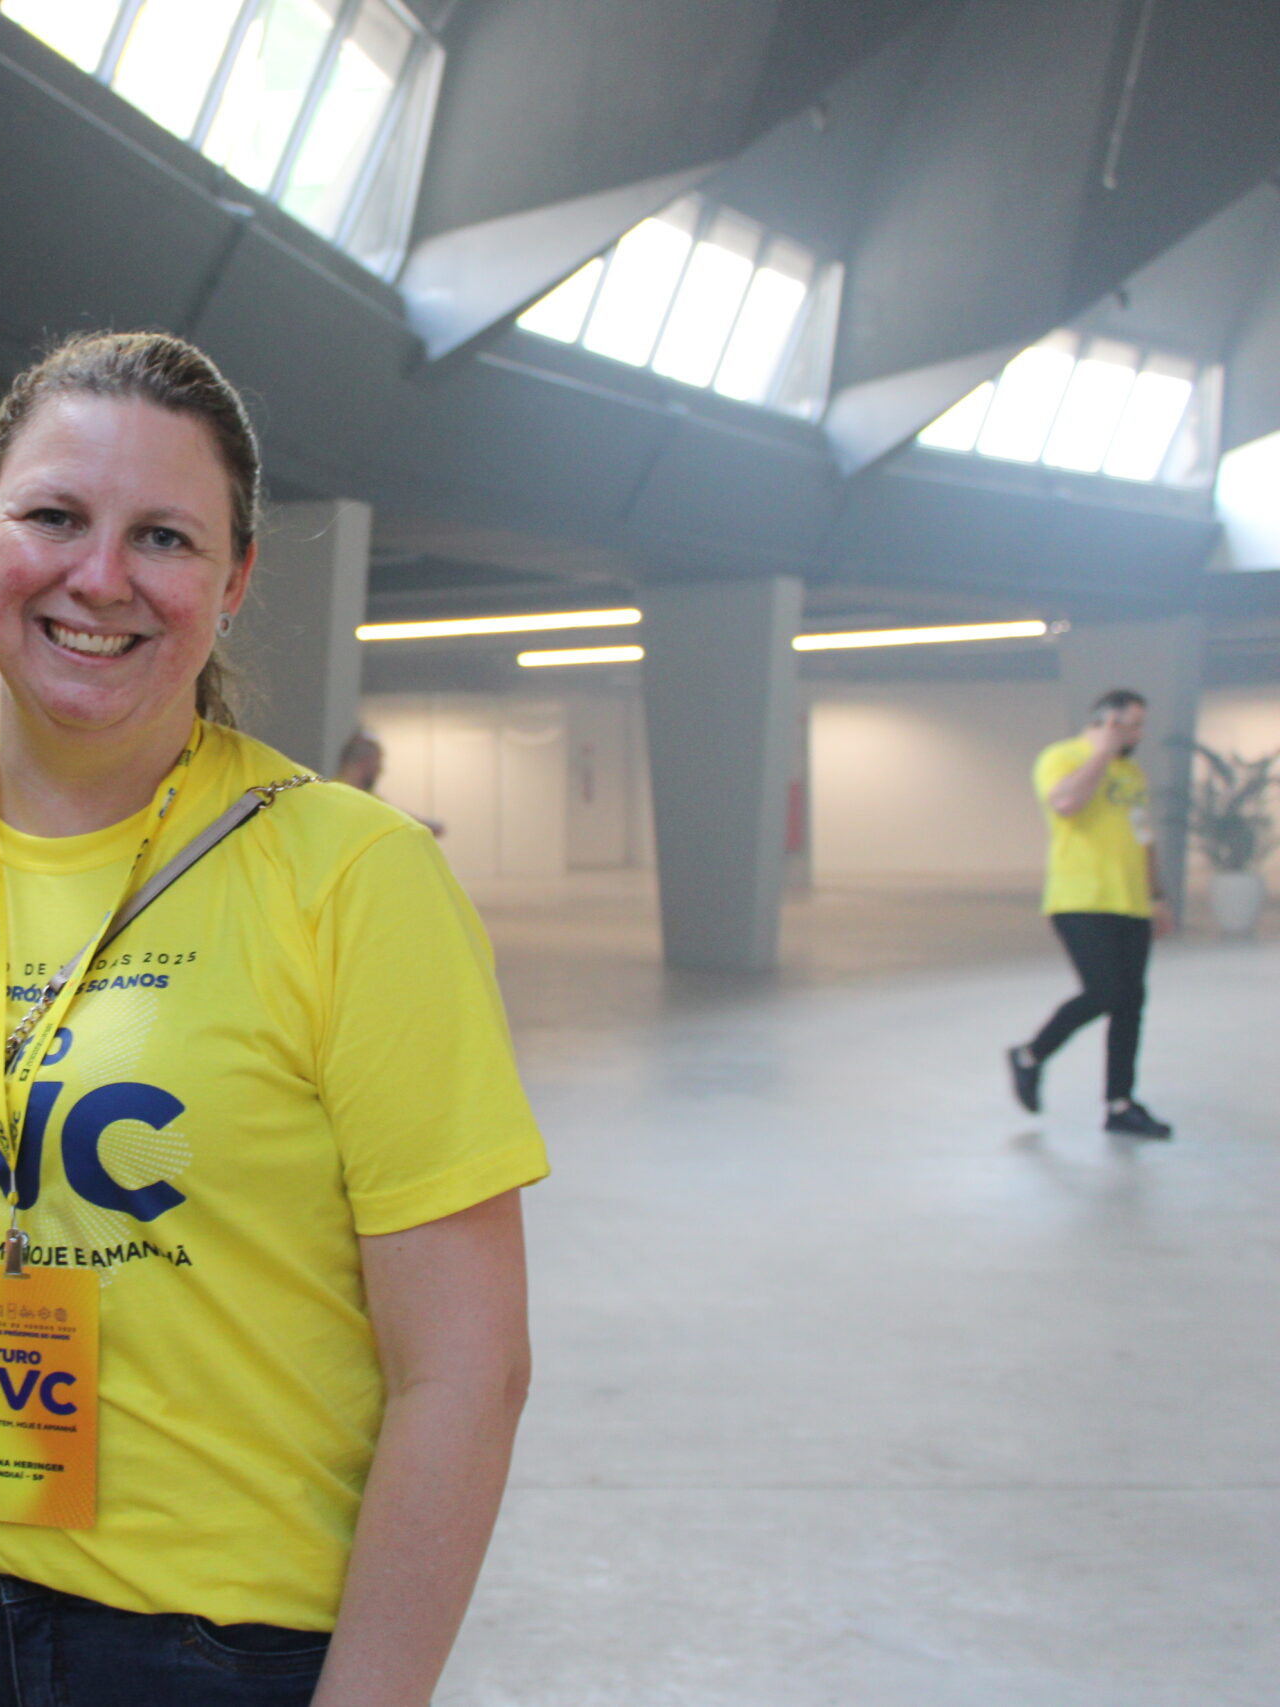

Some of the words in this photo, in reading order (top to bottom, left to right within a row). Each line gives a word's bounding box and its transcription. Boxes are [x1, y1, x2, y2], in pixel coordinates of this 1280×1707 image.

[24, 963, 46, 976] DE
[142, 951, 196, 965] 2025
[85, 978, 109, 992] 50
[110, 973, 169, 989] ANOS
[75, 1248, 87, 1266] E
[14, 1460, 65, 1472] HERINGER
[32, 1473, 44, 1481] SP
